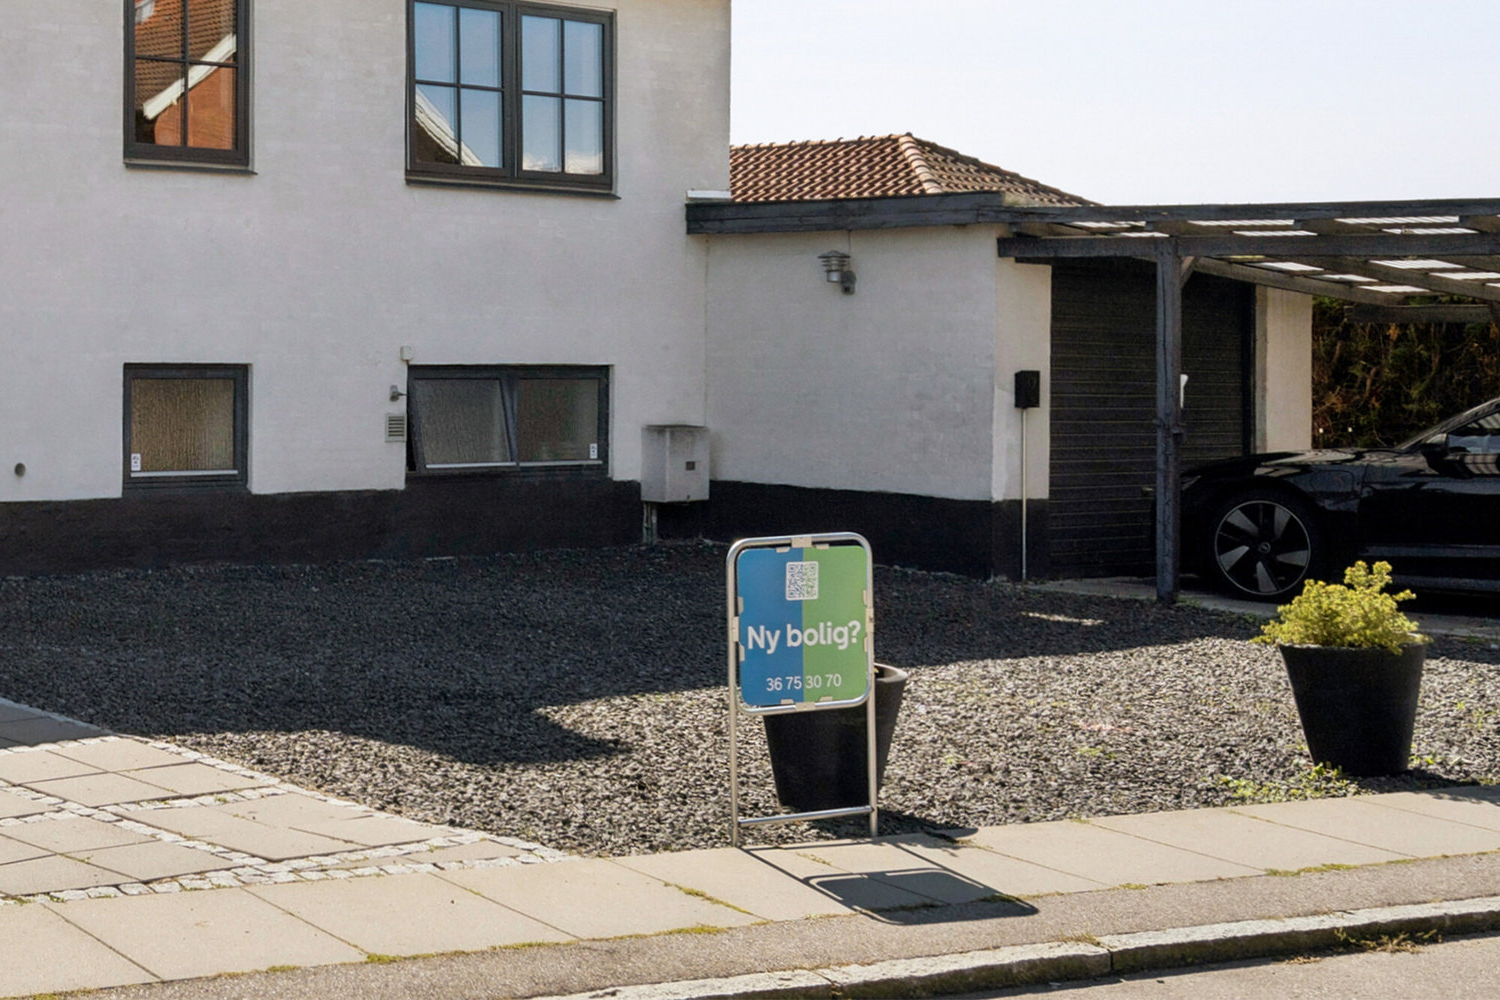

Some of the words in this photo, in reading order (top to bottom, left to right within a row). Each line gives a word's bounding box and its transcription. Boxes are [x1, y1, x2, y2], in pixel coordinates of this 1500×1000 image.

[747, 624, 781, 655] Ny
[786, 620, 862, 650] bolig?
[765, 676, 783, 692] 36
[785, 675, 803, 690] 75
[805, 674, 822, 689] 30
[824, 672, 842, 687] 70
